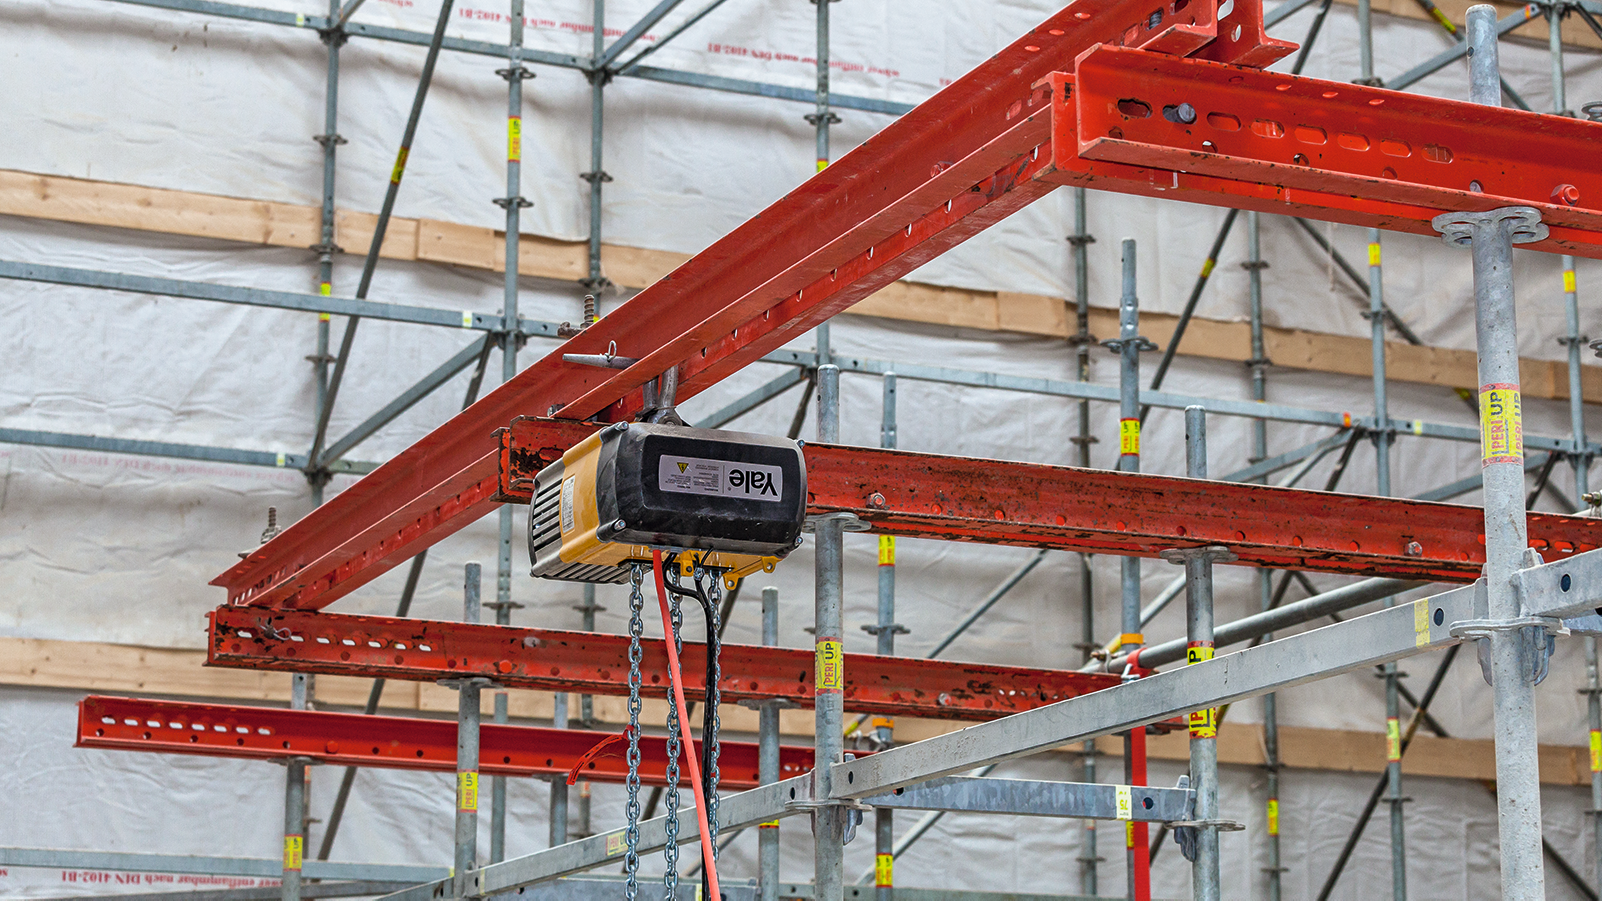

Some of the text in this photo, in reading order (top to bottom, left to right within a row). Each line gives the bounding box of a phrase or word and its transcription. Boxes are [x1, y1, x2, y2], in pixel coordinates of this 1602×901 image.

[1490, 392, 1504, 449] PERI UP
[729, 469, 778, 496] Yale
[825, 643, 834, 684] PERI UP
[465, 773, 473, 805] PERI UP
[1120, 800, 1128, 810] 75
[62, 871, 111, 883] 4102-B1
[114, 873, 140, 885] DIN
[144, 875, 174, 885] nach
